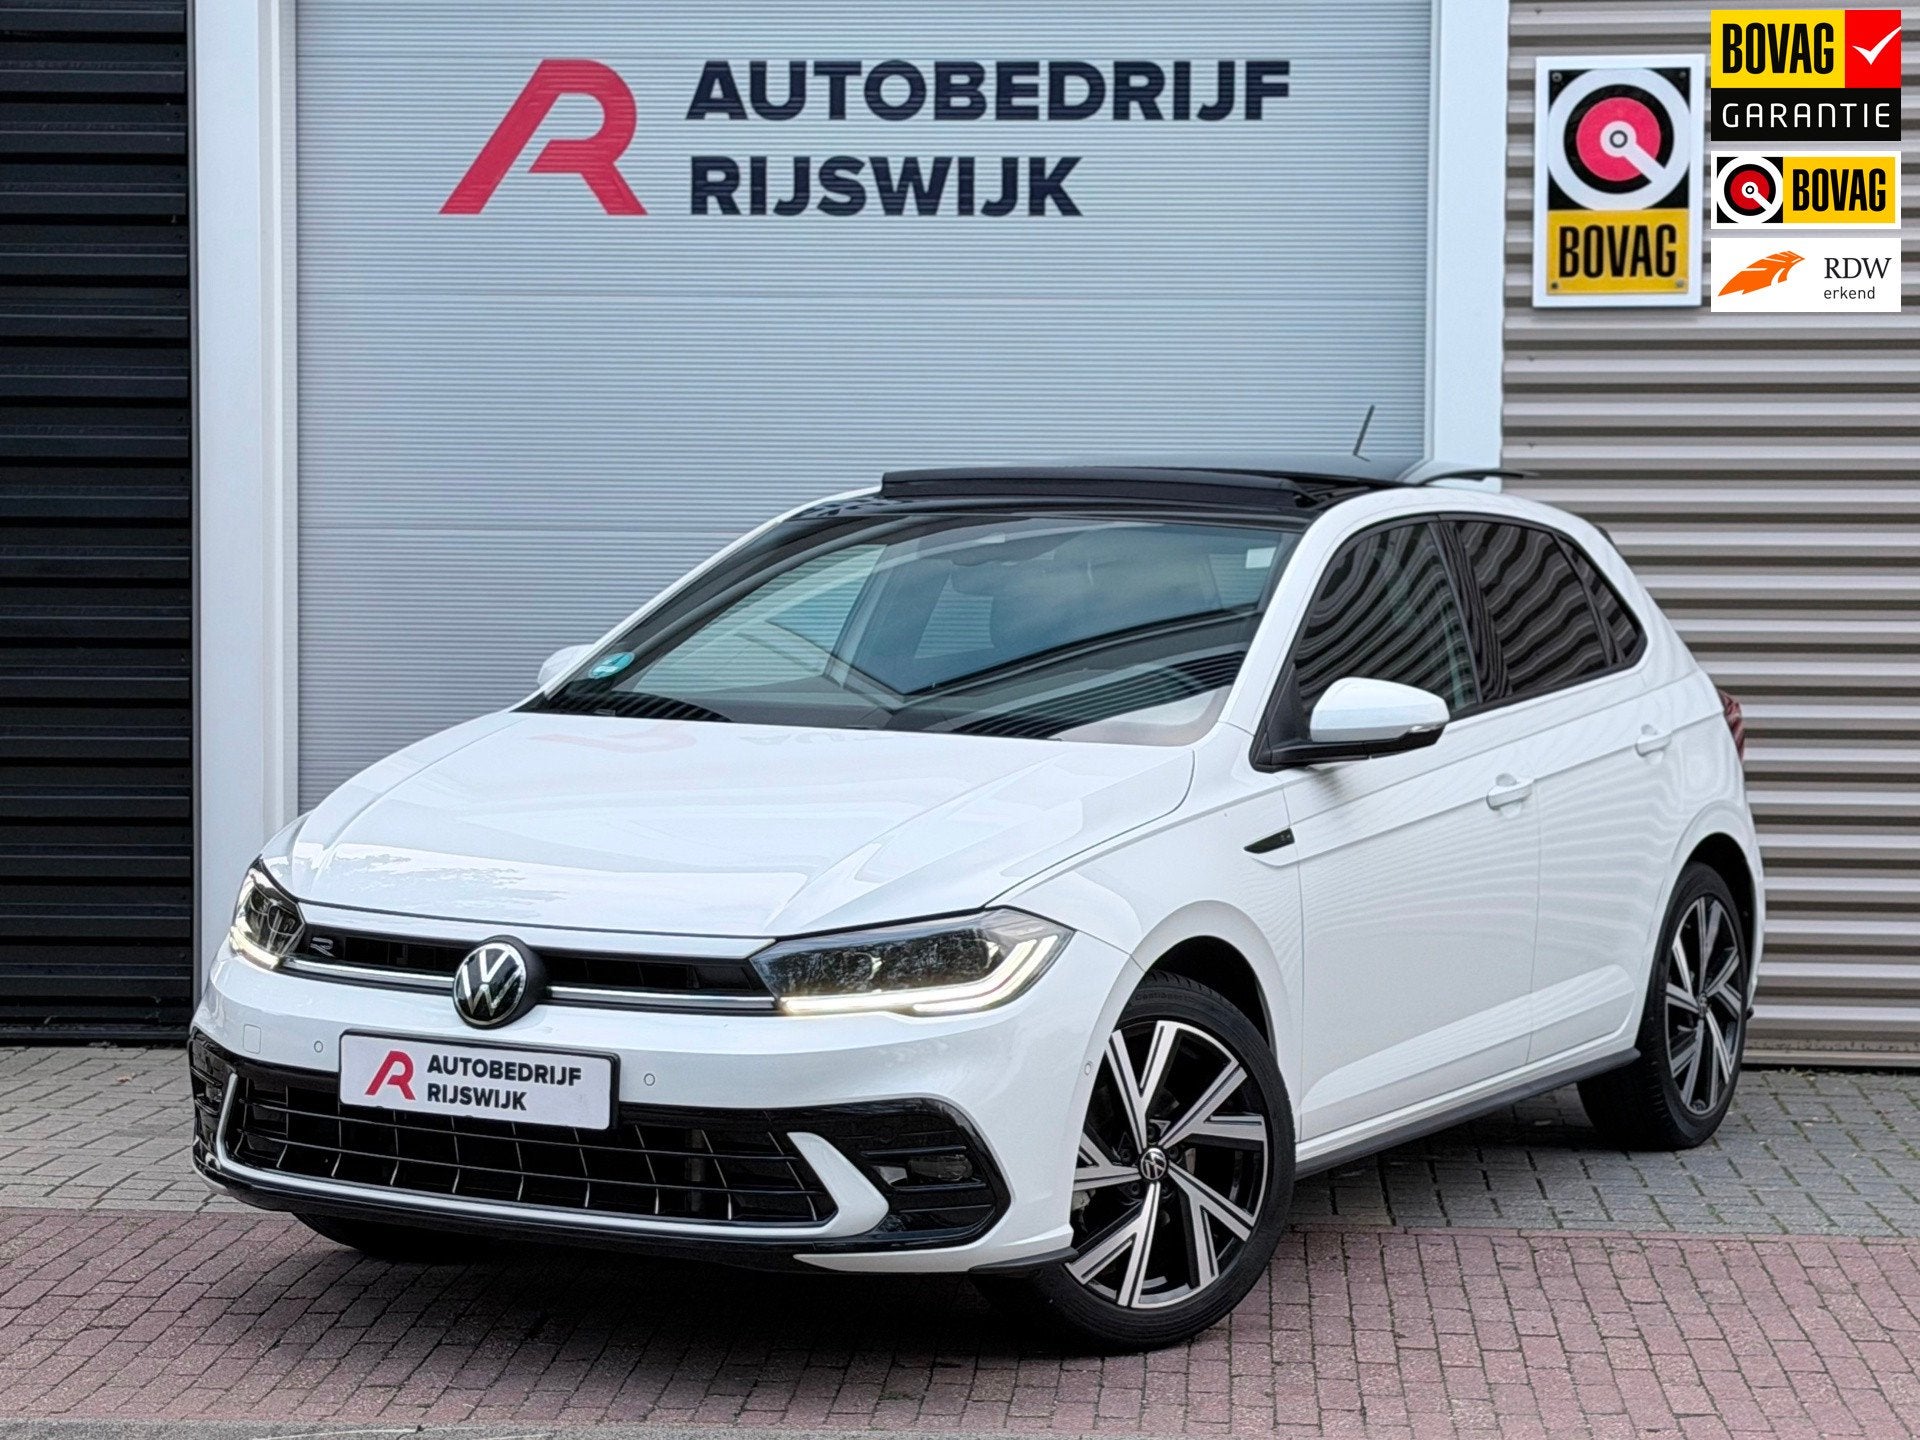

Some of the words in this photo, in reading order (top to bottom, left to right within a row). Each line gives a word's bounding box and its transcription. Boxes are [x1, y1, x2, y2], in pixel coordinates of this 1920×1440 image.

[686, 59, 1291, 122] AUTOBEDRIJF
[691, 155, 1083, 218] RIJSWIJK
[1558, 223, 1677, 279] BOVAG
[427, 1054, 582, 1087] AUTOBEDRIJF
[427, 1082, 527, 1111] RIJSWIJK
